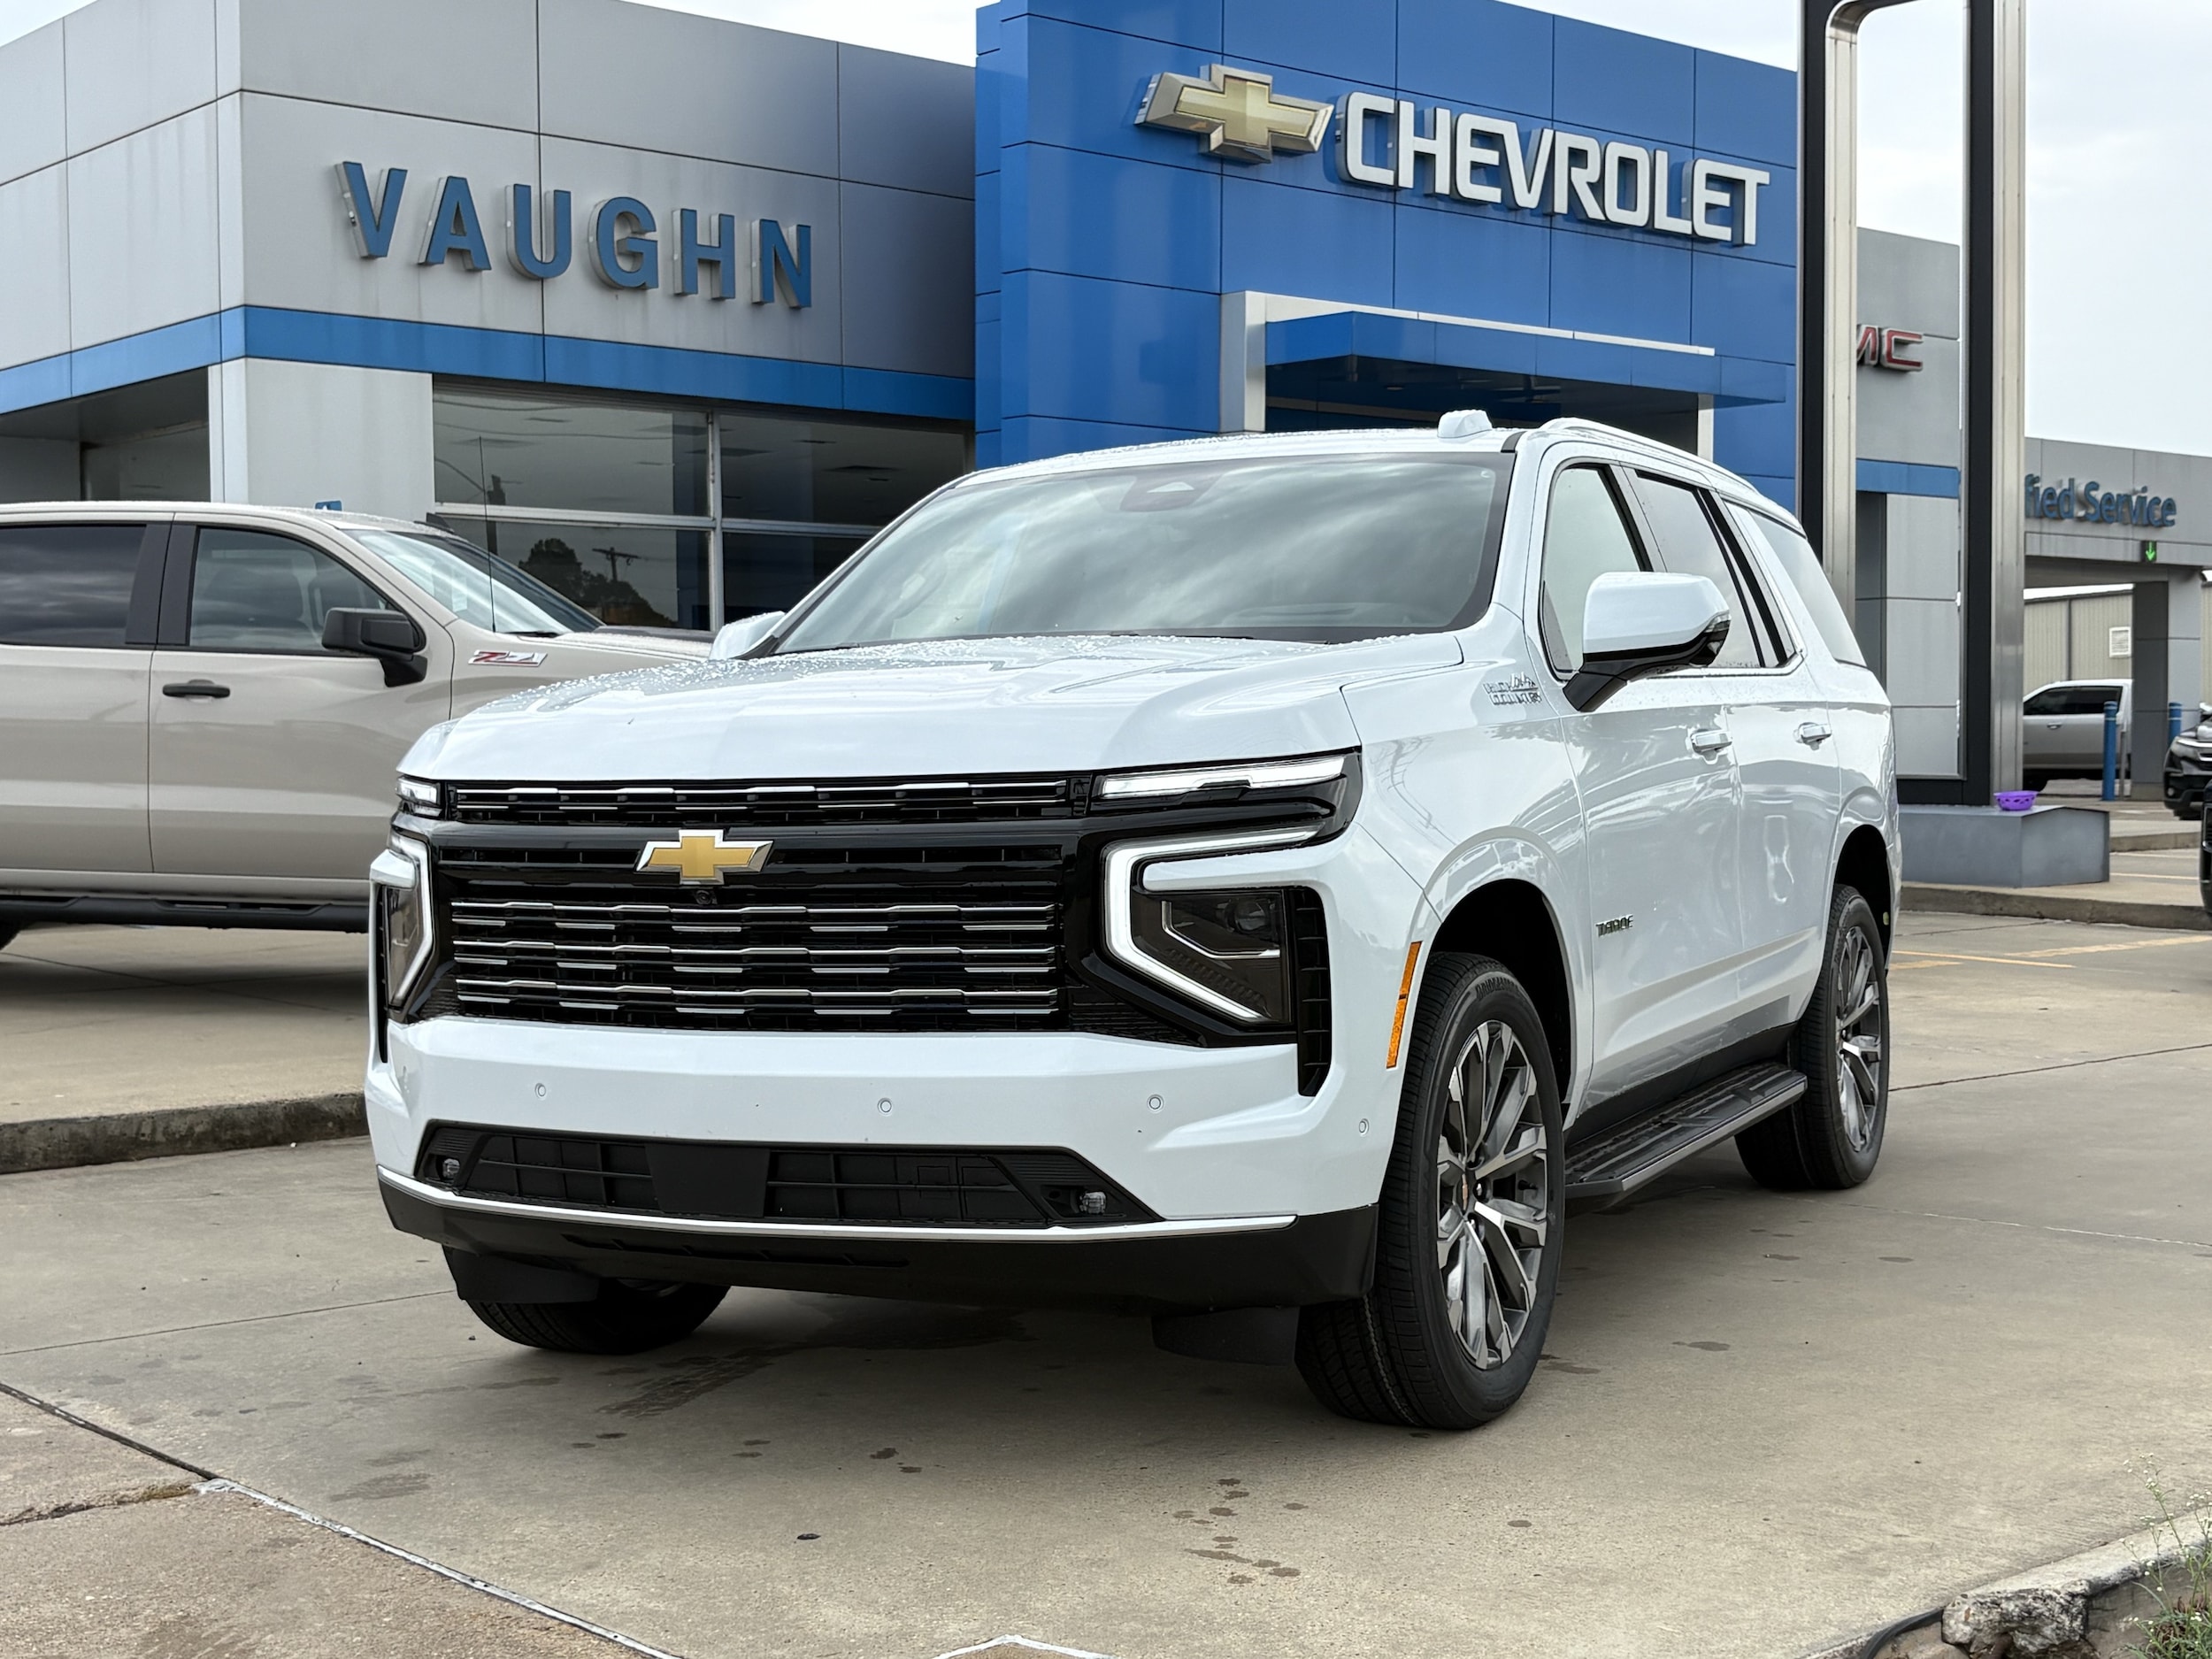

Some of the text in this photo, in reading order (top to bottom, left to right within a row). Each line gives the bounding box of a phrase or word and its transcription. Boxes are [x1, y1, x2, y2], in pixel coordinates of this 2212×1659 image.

[1337, 91, 1770, 247] CHEVROLET
[334, 160, 813, 309] VAUGHN
[2084, 480, 2177, 528] Service
[468, 649, 549, 667] Z71
[1594, 914, 1634, 938] TAHOE
